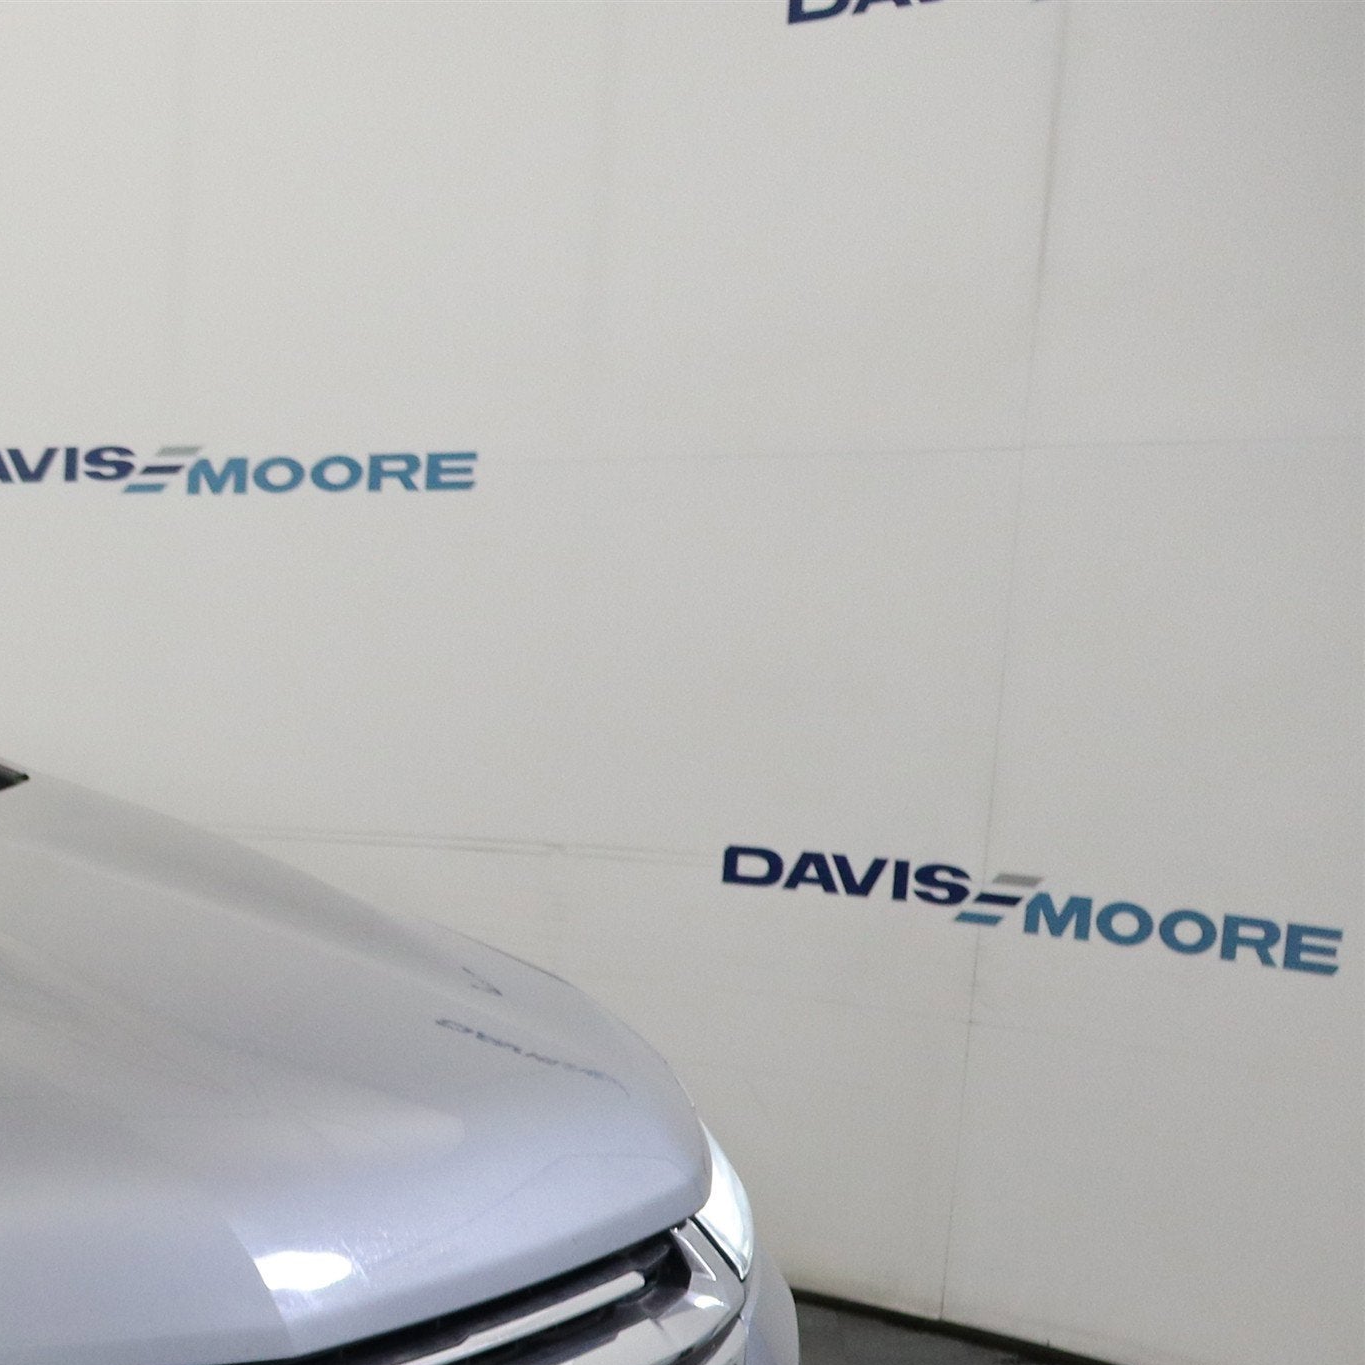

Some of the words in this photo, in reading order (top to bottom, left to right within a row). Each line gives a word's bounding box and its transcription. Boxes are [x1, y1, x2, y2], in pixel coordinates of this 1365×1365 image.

[187, 452, 478, 495] MOORE
[721, 844, 972, 906] DAVIS
[1023, 892, 1344, 976] MOORE
